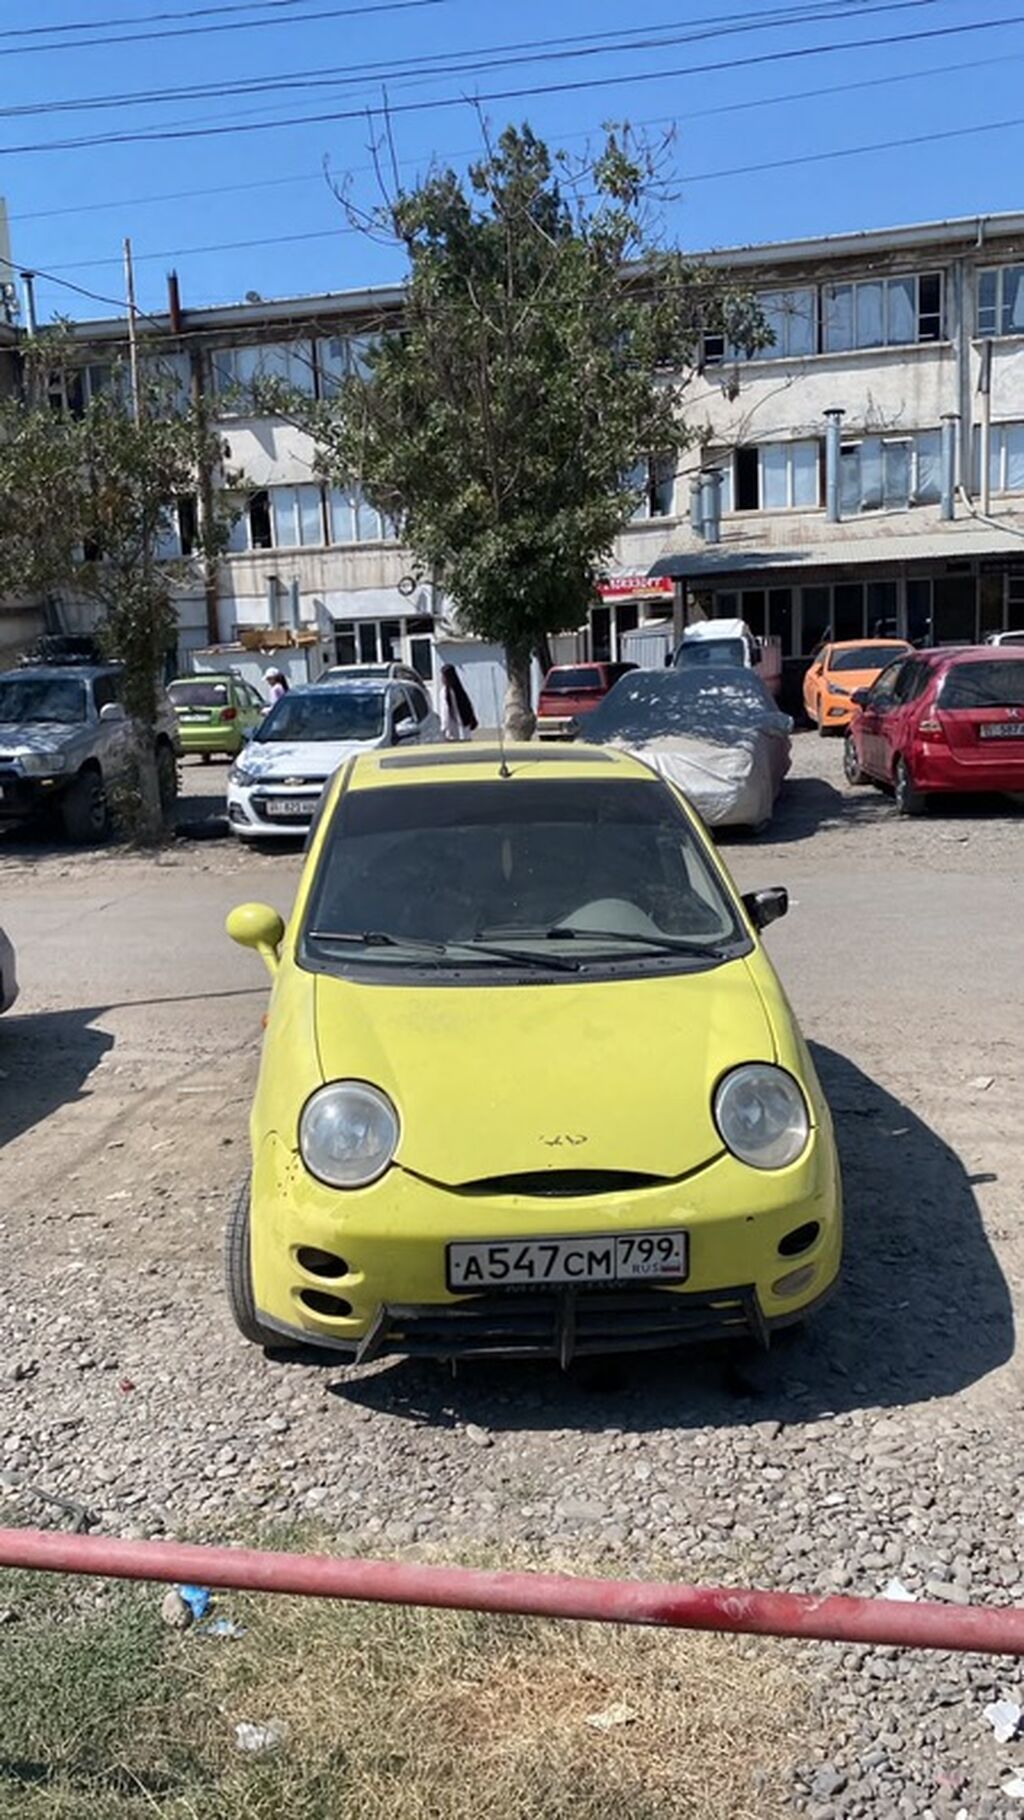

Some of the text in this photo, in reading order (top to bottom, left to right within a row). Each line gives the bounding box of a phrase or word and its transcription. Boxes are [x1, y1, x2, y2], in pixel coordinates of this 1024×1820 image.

[463, 1237, 673, 1281] A547CM 799
[631, 1262, 658, 1274] RUS
